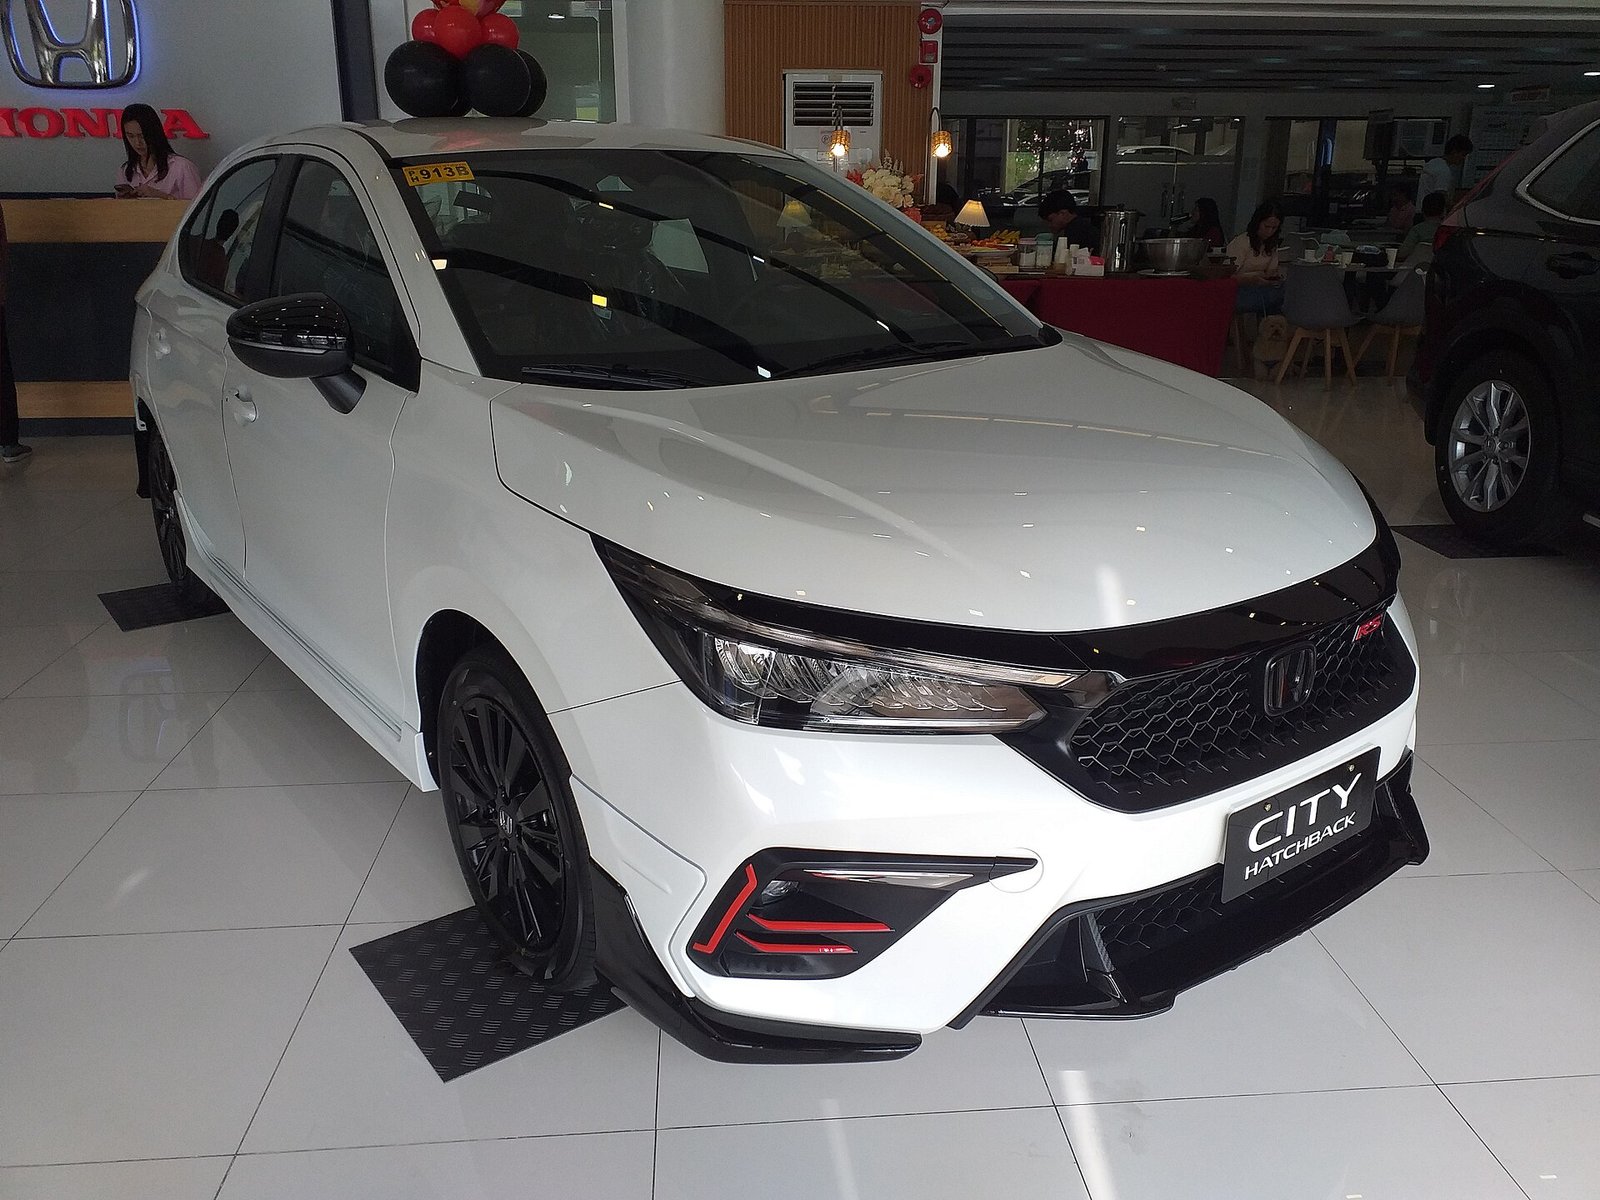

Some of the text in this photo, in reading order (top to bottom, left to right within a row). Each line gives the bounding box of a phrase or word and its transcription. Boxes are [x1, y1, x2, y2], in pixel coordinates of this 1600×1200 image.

[0, 107, 209, 139] ONA
[1355, 613, 1382, 641] RS
[1248, 772, 1362, 853] CITY
[1244, 811, 1357, 881] HATCHBACK
